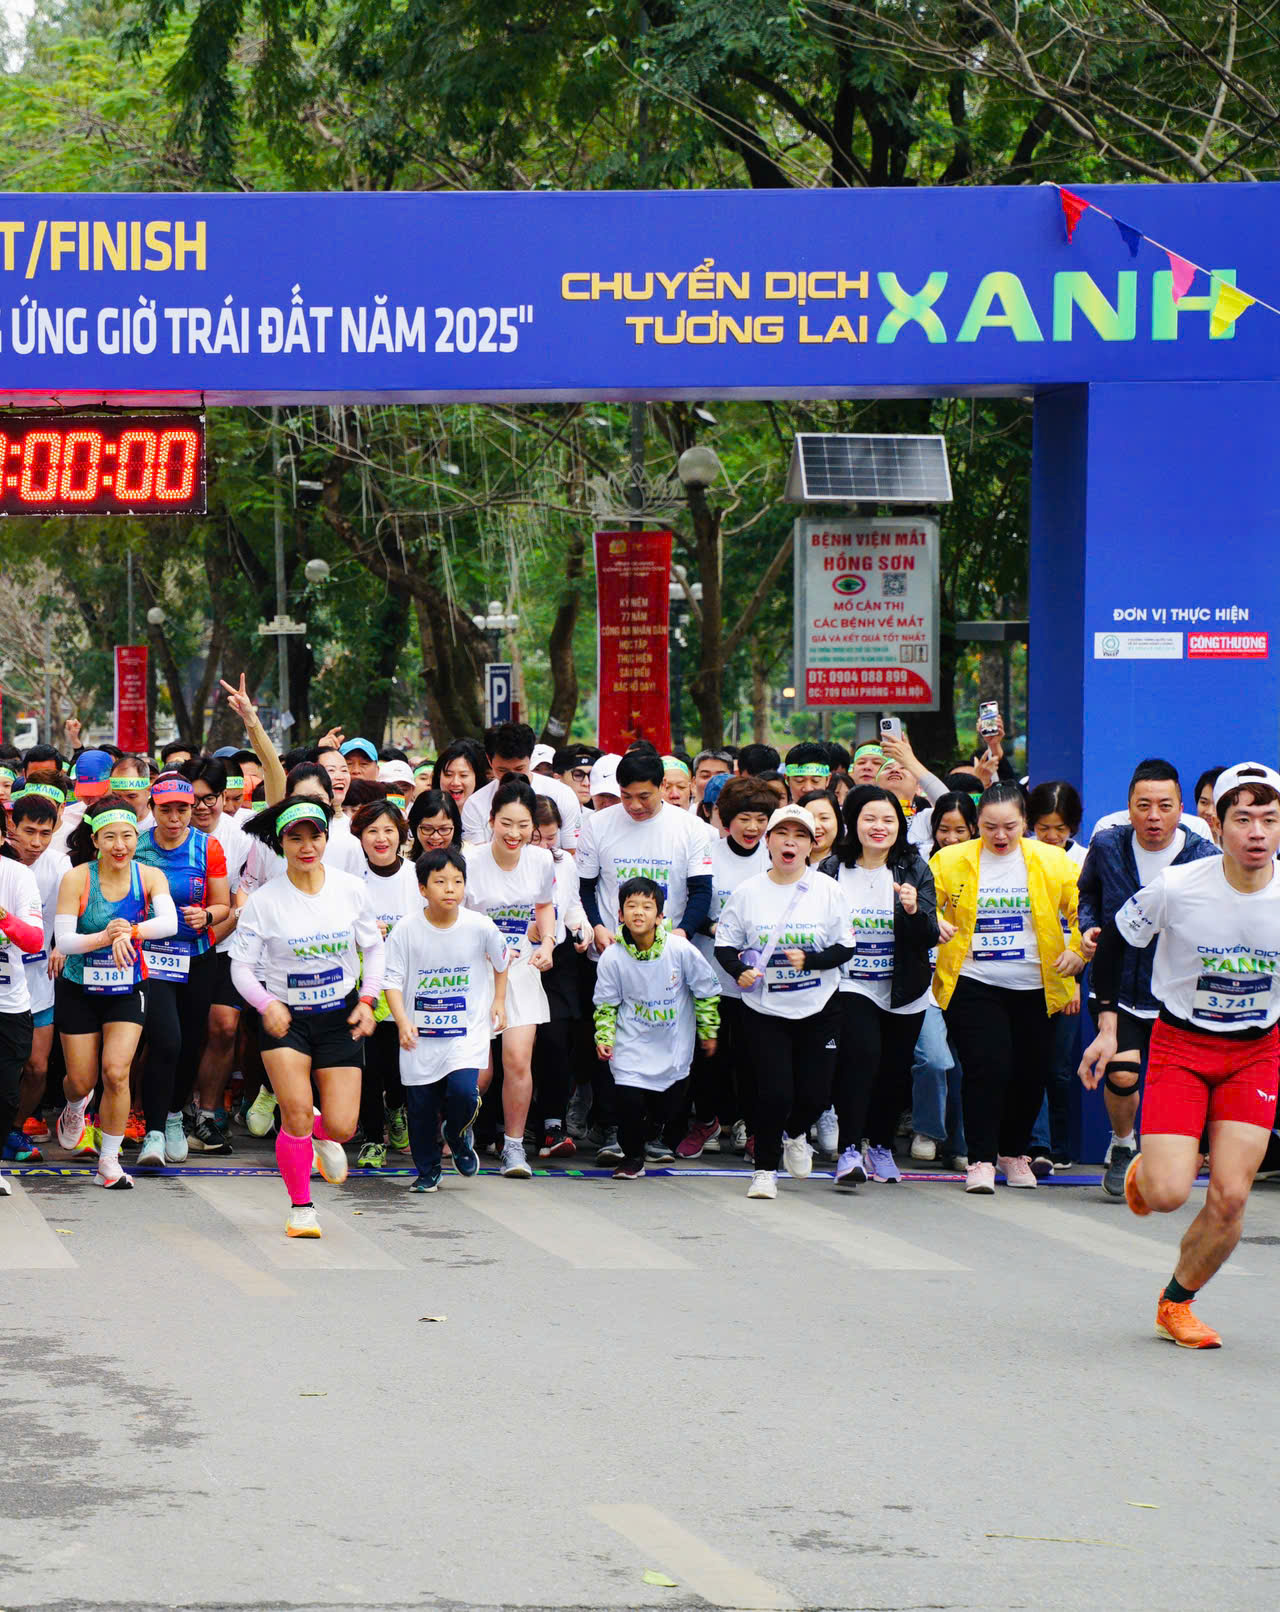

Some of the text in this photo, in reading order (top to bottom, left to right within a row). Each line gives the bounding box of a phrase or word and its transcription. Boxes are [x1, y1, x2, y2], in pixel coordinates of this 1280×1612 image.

[560, 258, 869, 306] CHUYỂN DỊCH
[876, 268, 1238, 344] XANH
[11, 295, 88, 354] ỨNG
[97, 295, 157, 354] GIỜ
[164, 294, 250, 354] TRÁI
[258, 283, 334, 354] ĐẤT
[340, 294, 426, 353] NĂM
[435, 305, 534, 353] 2025"
[625, 309, 869, 345] TƯƠNG LAI
[811, 529, 927, 549] BỆNH VIỆN MẮT
[878, 555, 915, 571] SƠN
[884, 601, 905, 613] THỊ
[1113, 605, 1249, 624] ĐƠN VỊ THỰC HIỆN
[840, 617, 875, 631] BỆNH
[493, 677, 507, 719] P
[852, 917, 894, 929] ANH
[980, 935, 1015, 947] 3.537
[149, 956, 181, 968] 3.931
[93, 969, 125, 981] 3.181
[298, 986, 336, 1001] 3.183
[1207, 995, 1256, 1009] 3.741
[423, 1014, 459, 1025] 3.678
